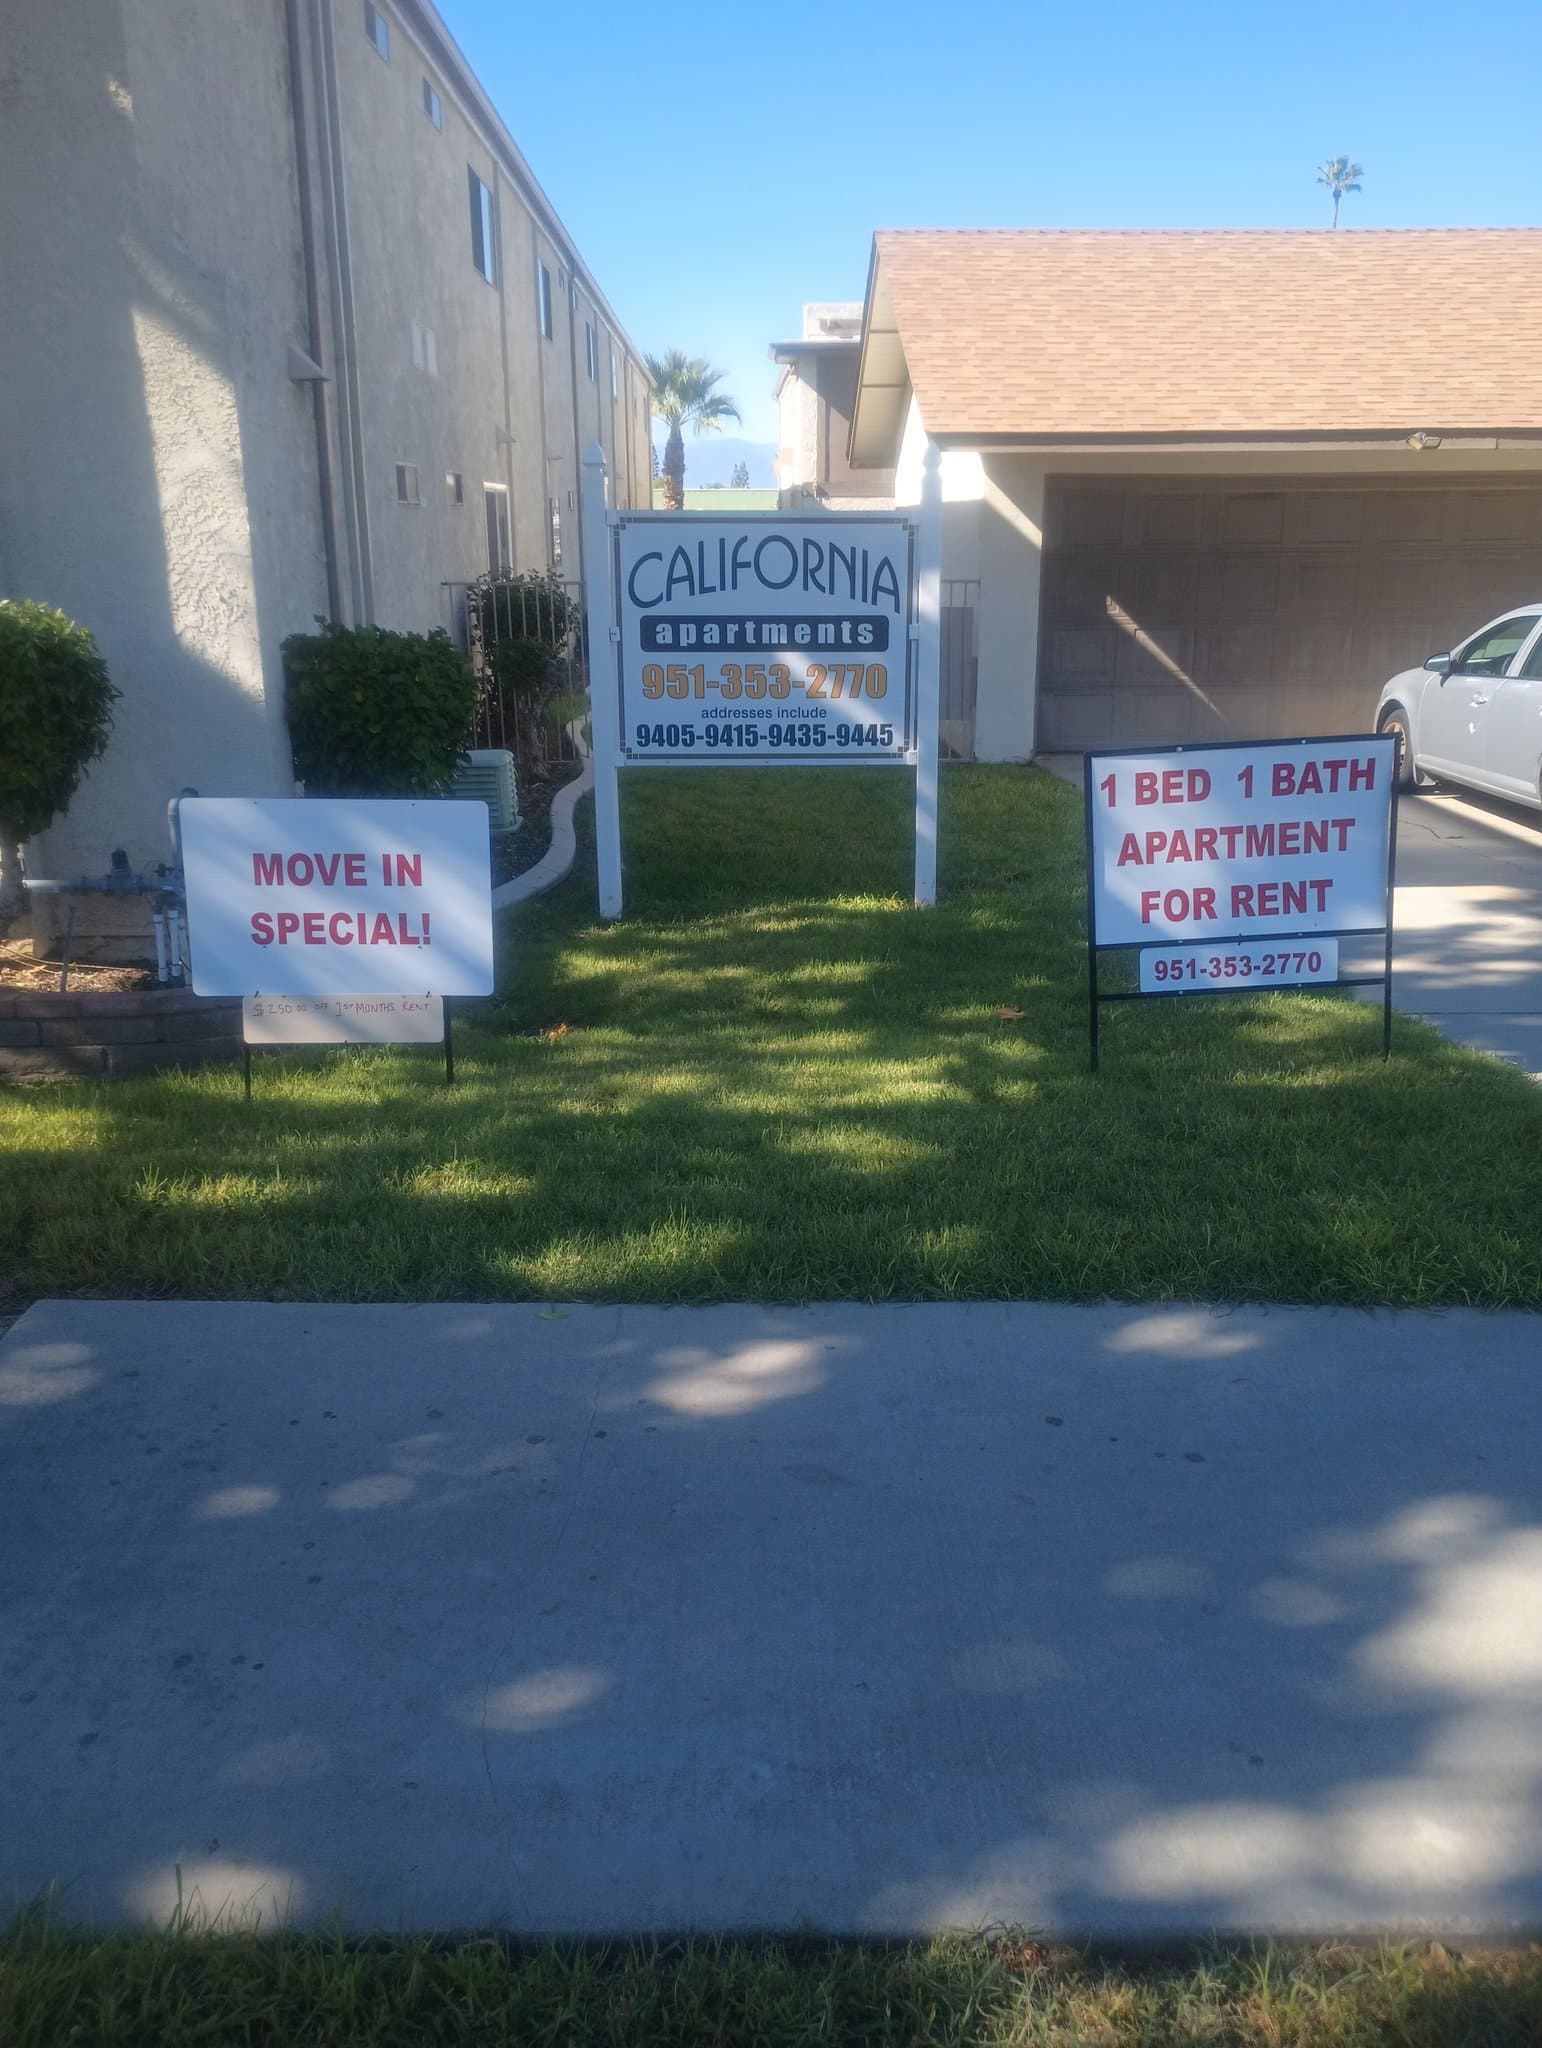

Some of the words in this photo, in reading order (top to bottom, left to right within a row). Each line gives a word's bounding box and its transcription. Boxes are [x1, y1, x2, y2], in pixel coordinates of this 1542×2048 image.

[627, 534, 901, 614] CALIFORNIA
[655, 620, 875, 647] apartments
[641, 663, 888, 700] 951-353-2770
[701, 707, 773, 719] addresses
[777, 706, 827, 719] include
[636, 723, 893, 748] 9405-9415-9435-9445
[1100, 773, 1117, 808] 1
[1135, 768, 1211, 806] BED
[1237, 764, 1254, 799] 1
[1271, 757, 1376, 797] BATH
[1117, 818, 1356, 867] APARTMENT
[252, 853, 367, 887] MOVE
[382, 853, 423, 887] IN
[1141, 887, 1218, 924] FOR
[1230, 878, 1334, 918] RENT
[251, 912, 432, 946] SPECIAL!
[1154, 951, 1322, 982] 951-353-2770
